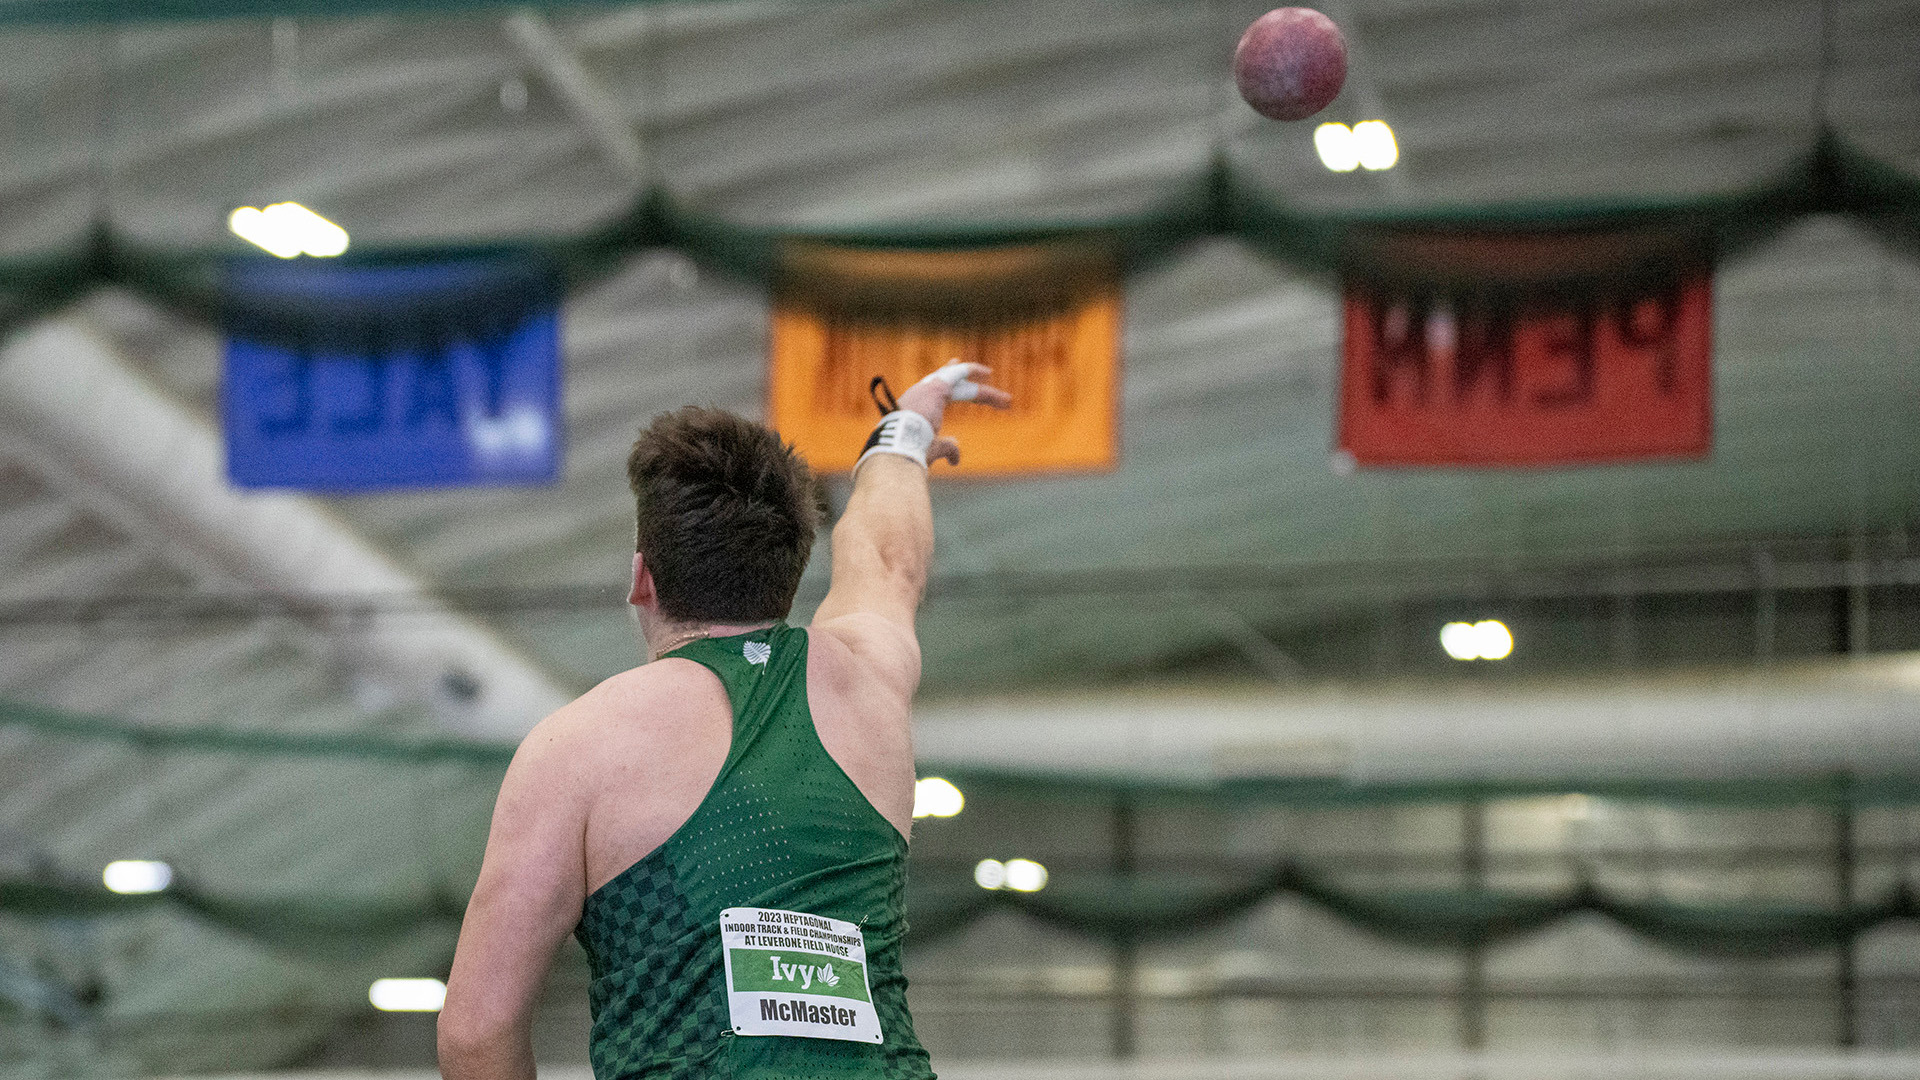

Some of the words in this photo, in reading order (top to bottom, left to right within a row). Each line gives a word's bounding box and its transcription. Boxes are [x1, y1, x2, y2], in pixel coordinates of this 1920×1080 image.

[758, 911, 782, 923] 2023
[784, 913, 833, 932] HEPTAGONAL
[725, 924, 756, 933] INDOOR
[757, 924, 782, 935] TRACK
[784, 927, 790, 935] &
[791, 927, 808, 937] FIELD
[809, 929, 862, 947] CHAMPIONSHIPS
[744, 935, 756, 946] AT
[758, 936, 802, 949] LEVERONE
[803, 940, 824, 951] FIELD
[826, 943, 849, 957] HOUSE
[769, 956, 815, 990] Ivy
[760, 999, 856, 1027] McMaster
